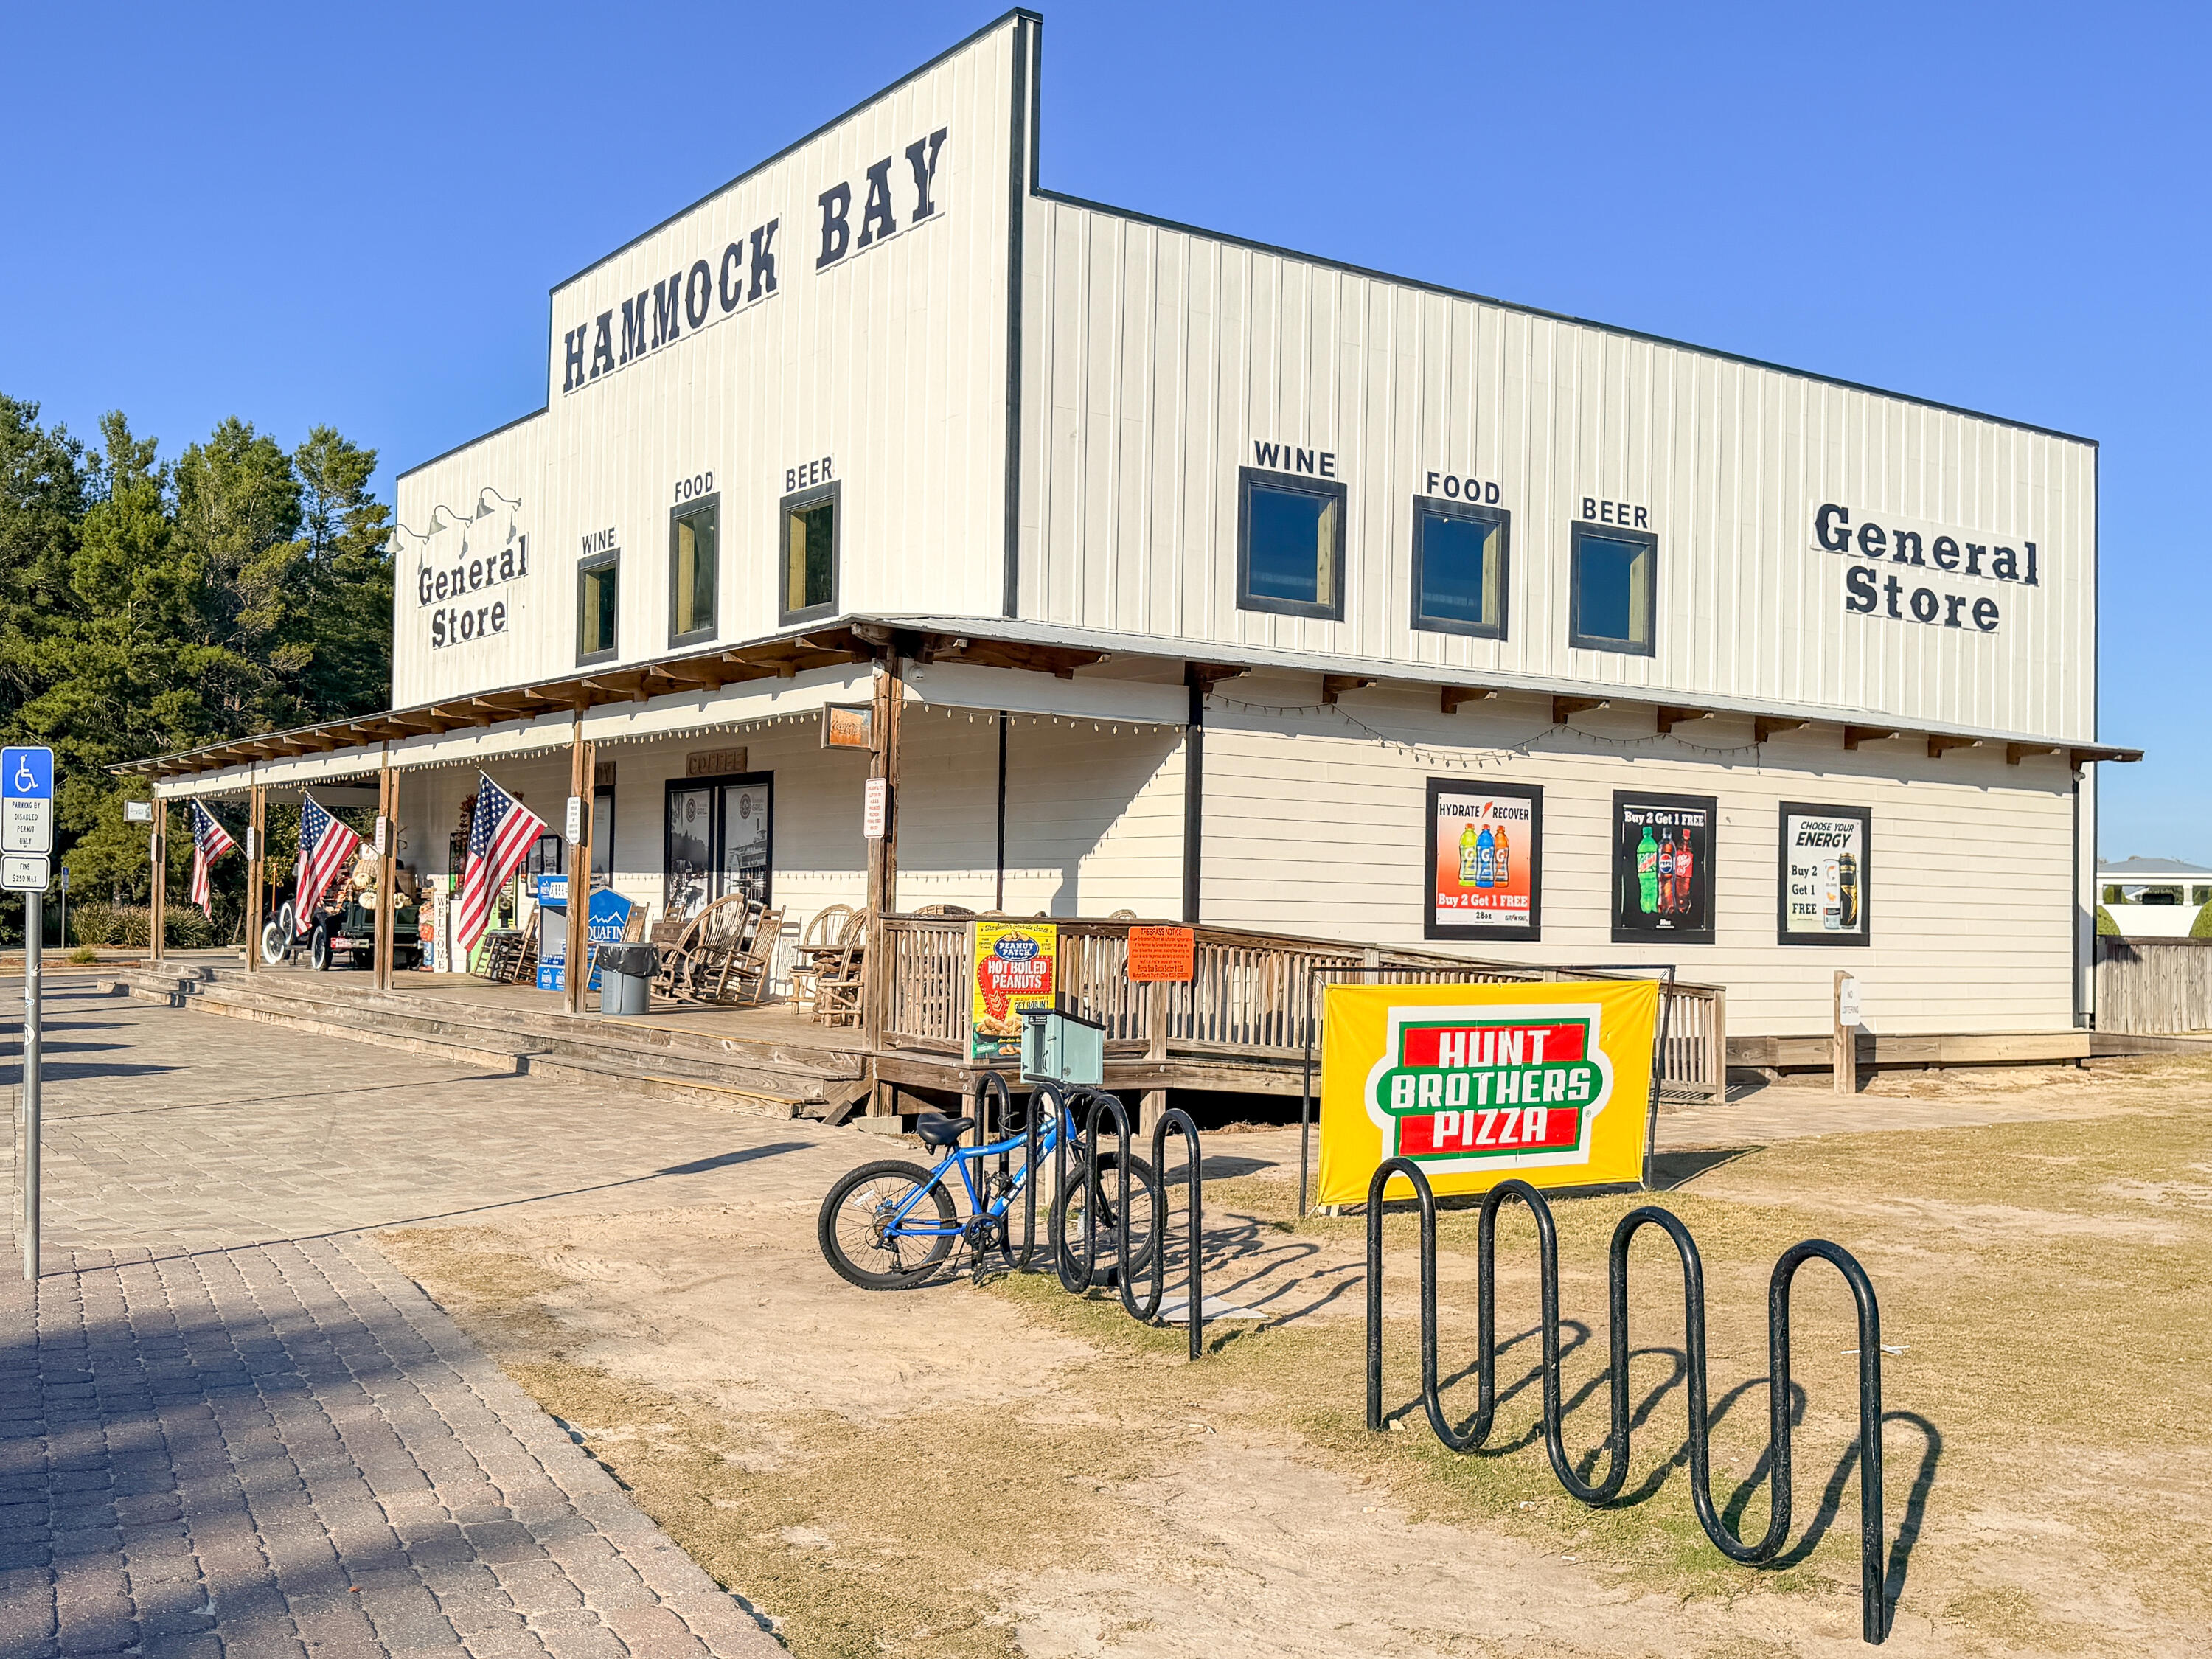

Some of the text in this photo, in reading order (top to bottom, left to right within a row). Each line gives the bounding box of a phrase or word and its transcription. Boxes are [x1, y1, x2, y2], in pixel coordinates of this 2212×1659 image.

[563, 126, 947, 393] HAMMOCK BAY
[1254, 440, 1335, 477] WINE
[786, 456, 832, 493] BEER
[675, 471, 714, 503] FOOD
[1427, 471, 1500, 505] FOOD
[1583, 497, 1648, 529] BEER
[582, 527, 615, 554] WINE
[1815, 504, 2039, 585] General
[419, 535, 526, 605] General
[1846, 566, 1999, 630] Store
[432, 601, 506, 647] Store
[689, 751, 744, 775] COFFEE
[1439, 804, 1529, 821] HYDRATE RECOVER
[1624, 811, 1705, 827] Buy 2 Get 1 FREE
[1801, 821, 1854, 832] CHOOSE YOUR
[1795, 832, 1852, 848] ENERGY
[1464, 849, 1474, 861] G
[1481, 849, 1490, 861] G
[1496, 849, 1505, 862] G
[1791, 865, 1818, 878] Buy 2
[1439, 893, 1528, 907] Buy 2 Get 1 FREE
[1792, 884, 1815, 895] Get 1
[1475, 911, 1492, 919] 28oz
[1792, 903, 1817, 914] FREE
[987, 959, 1047, 975] HOT BOILED
[992, 974, 1043, 989] PEANUTS
[1439, 1029, 1550, 1068] HUNT
[1391, 1068, 1591, 1109] BROTHERS
[1433, 1107, 1548, 1147] PIZZA
